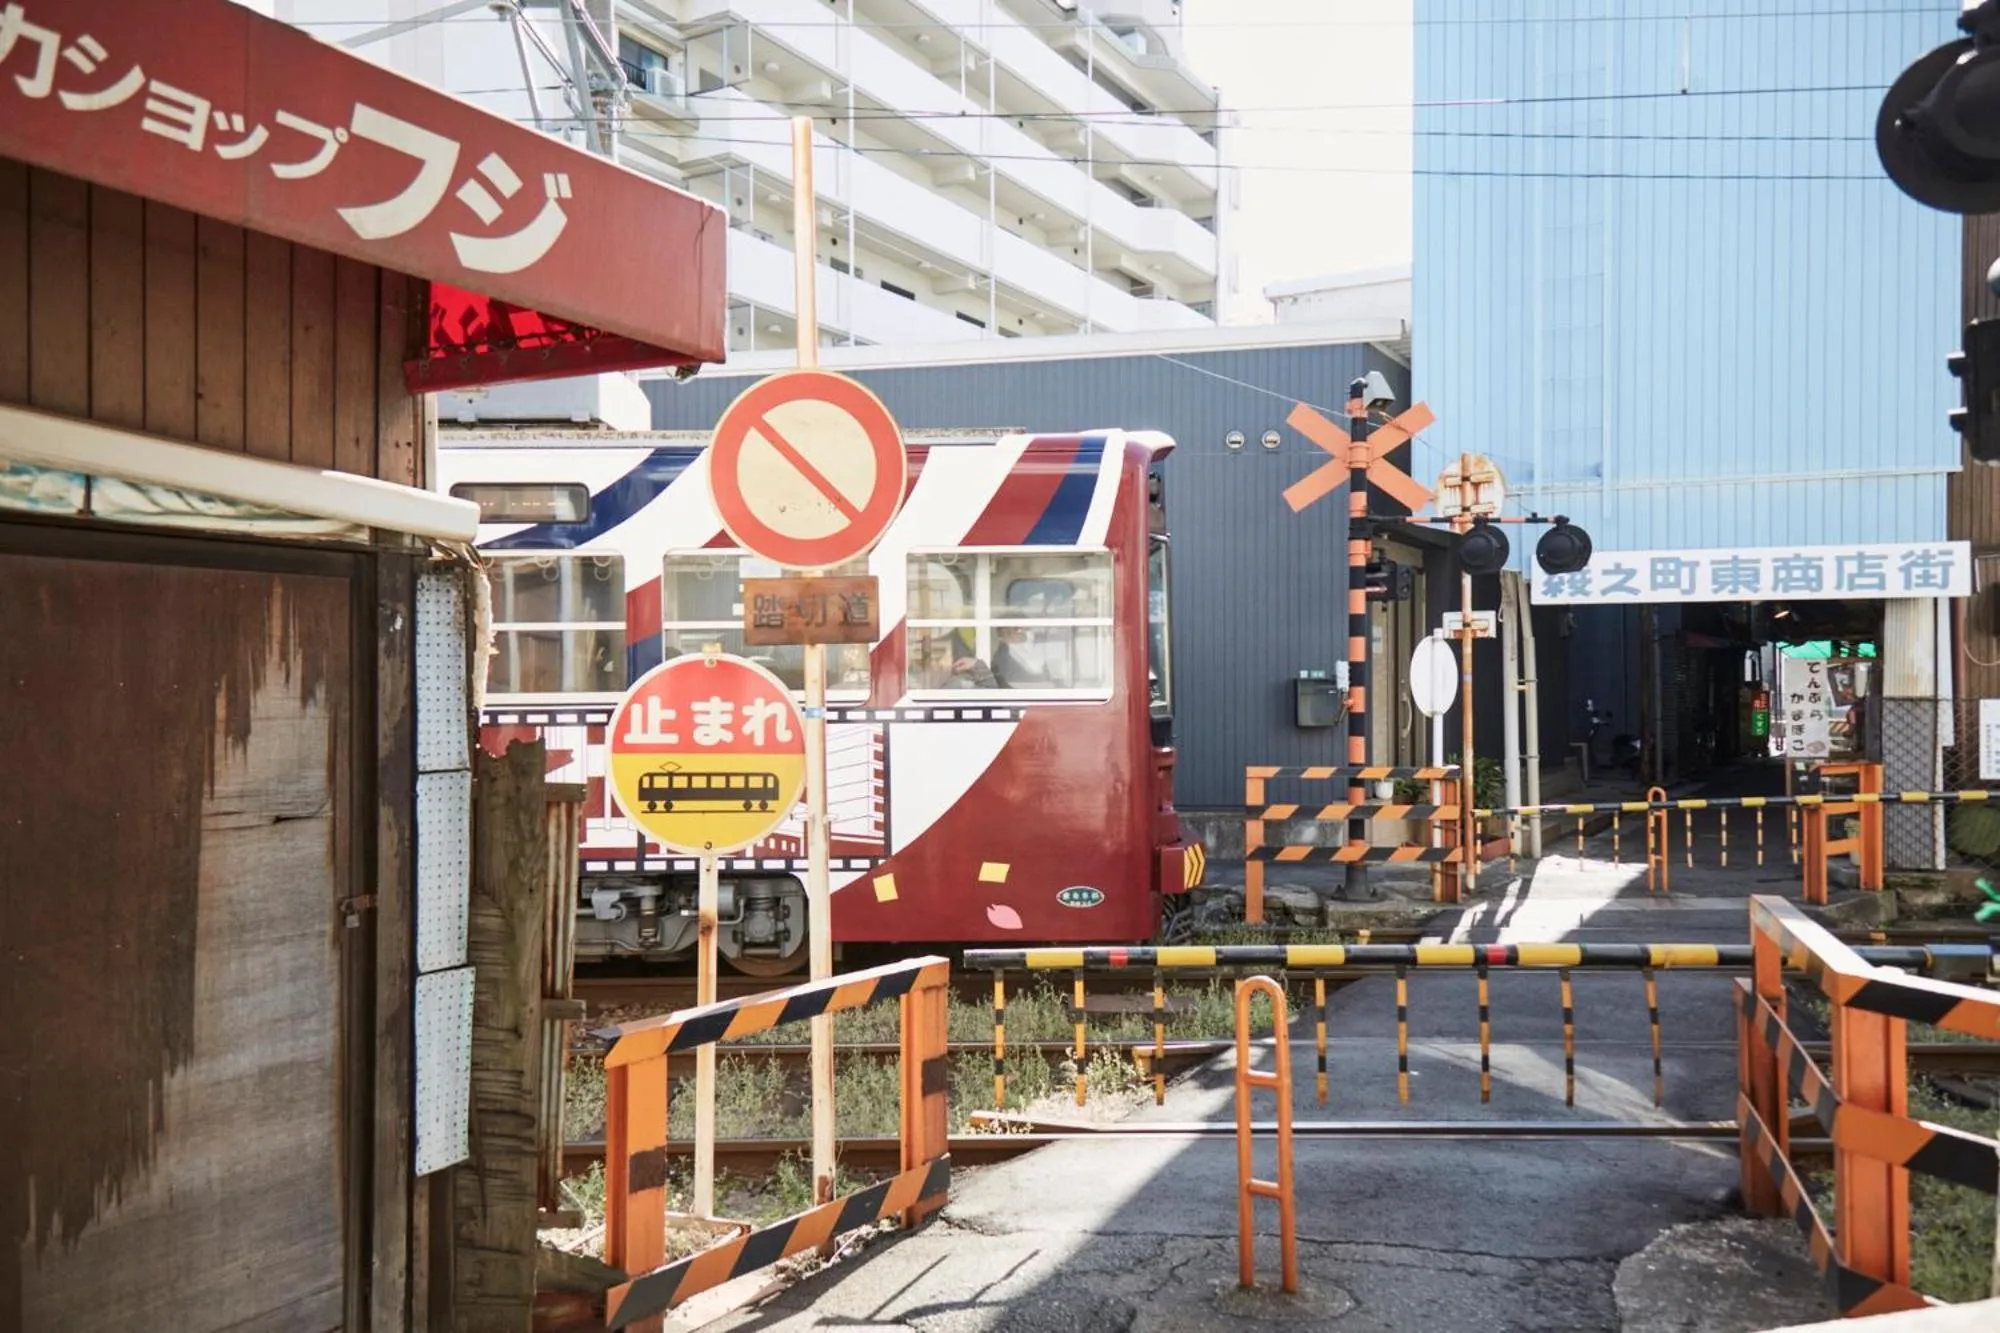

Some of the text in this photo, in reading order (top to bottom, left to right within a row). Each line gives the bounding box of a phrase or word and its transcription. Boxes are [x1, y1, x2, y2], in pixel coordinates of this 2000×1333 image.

[1541, 550, 1955, 598] 綾之町東商店街
[753, 592, 871, 628] 踏切道
[623, 695, 793, 746] 止まれ
[1790, 693, 1805, 751] かまぼこ
